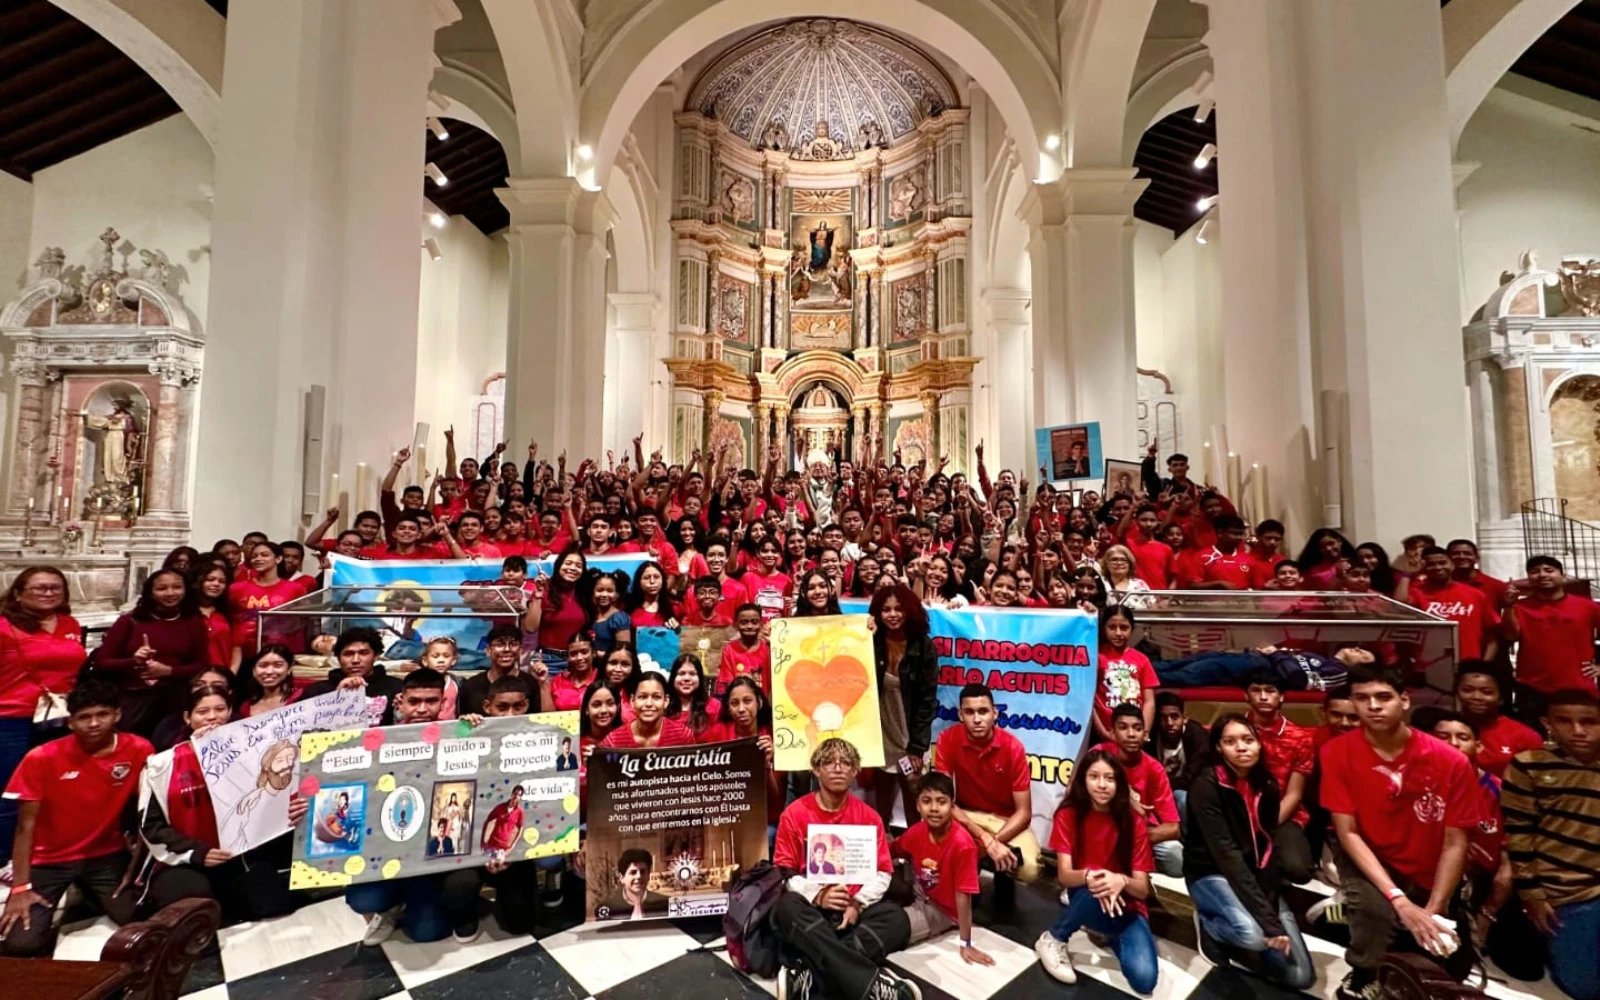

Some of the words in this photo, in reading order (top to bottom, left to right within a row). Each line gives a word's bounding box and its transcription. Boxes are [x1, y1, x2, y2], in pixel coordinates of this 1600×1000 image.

[955, 637, 1090, 667] PARROQUIA
[987, 669, 1070, 696] ACUTIS
[384, 744, 432, 759] siempre
[443, 741, 476, 753] unido
[504, 740, 523, 748] ese
[525, 739, 537, 747] es
[540, 736, 553, 746] mi
[504, 754, 551, 768] proyecto
[644, 747, 731, 771] Eucaristía
[617, 779, 628, 788] mi
[630, 776, 668, 787] autopista
[669, 774, 691, 783] hacia
[693, 772, 700, 780] el
[702, 771, 724, 780] Cielo.
[725, 770, 751, 779] Somos
[523, 786, 537, 796] de
[612, 790, 629, 800] más
[631, 786, 679, 798] afortunados
[680, 785, 695, 794] que
[696, 783, 708, 792] los
[709, 781, 747, 792] apóstoles
[614, 803, 630, 812] que
[631, 799, 663, 808] vivieron
[664, 798, 679, 806] con
[702, 794, 721, 802] hace
[722, 791, 745, 801] 2000
[631, 812, 650, 822] para
[651, 807, 704, 819] encontrarnos
[705, 806, 719, 814] con
[729, 803, 751, 812] basta
[618, 825, 633, 833] con
[635, 823, 650, 832] que
[652, 819, 690, 830] entremos
[703, 816, 711, 825] la
